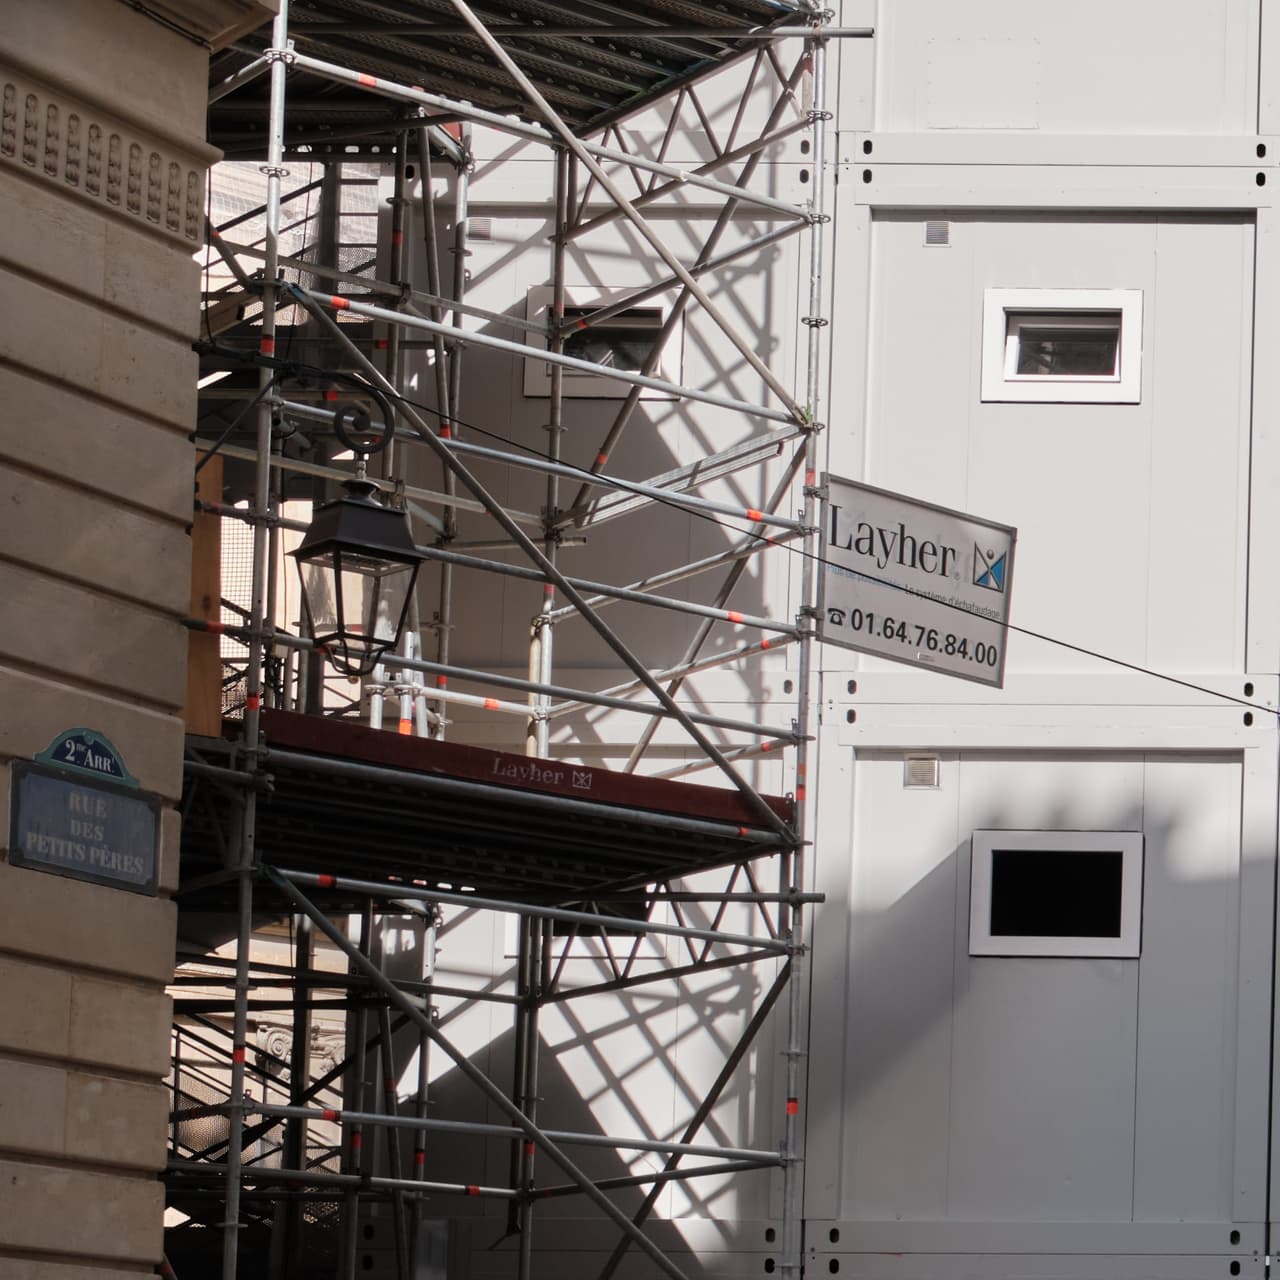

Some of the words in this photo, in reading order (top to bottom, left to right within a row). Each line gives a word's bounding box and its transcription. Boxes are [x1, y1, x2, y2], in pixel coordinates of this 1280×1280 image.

[828, 504, 956, 577] Layher
[851, 608, 998, 667] 01.64.76.84.00
[492, 758, 564, 785] Layher
[69, 791, 107, 818] RUE
[71, 819, 105, 841] DES
[26, 832, 86, 864] PETITS
[89, 844, 145, 874] PÈRES
